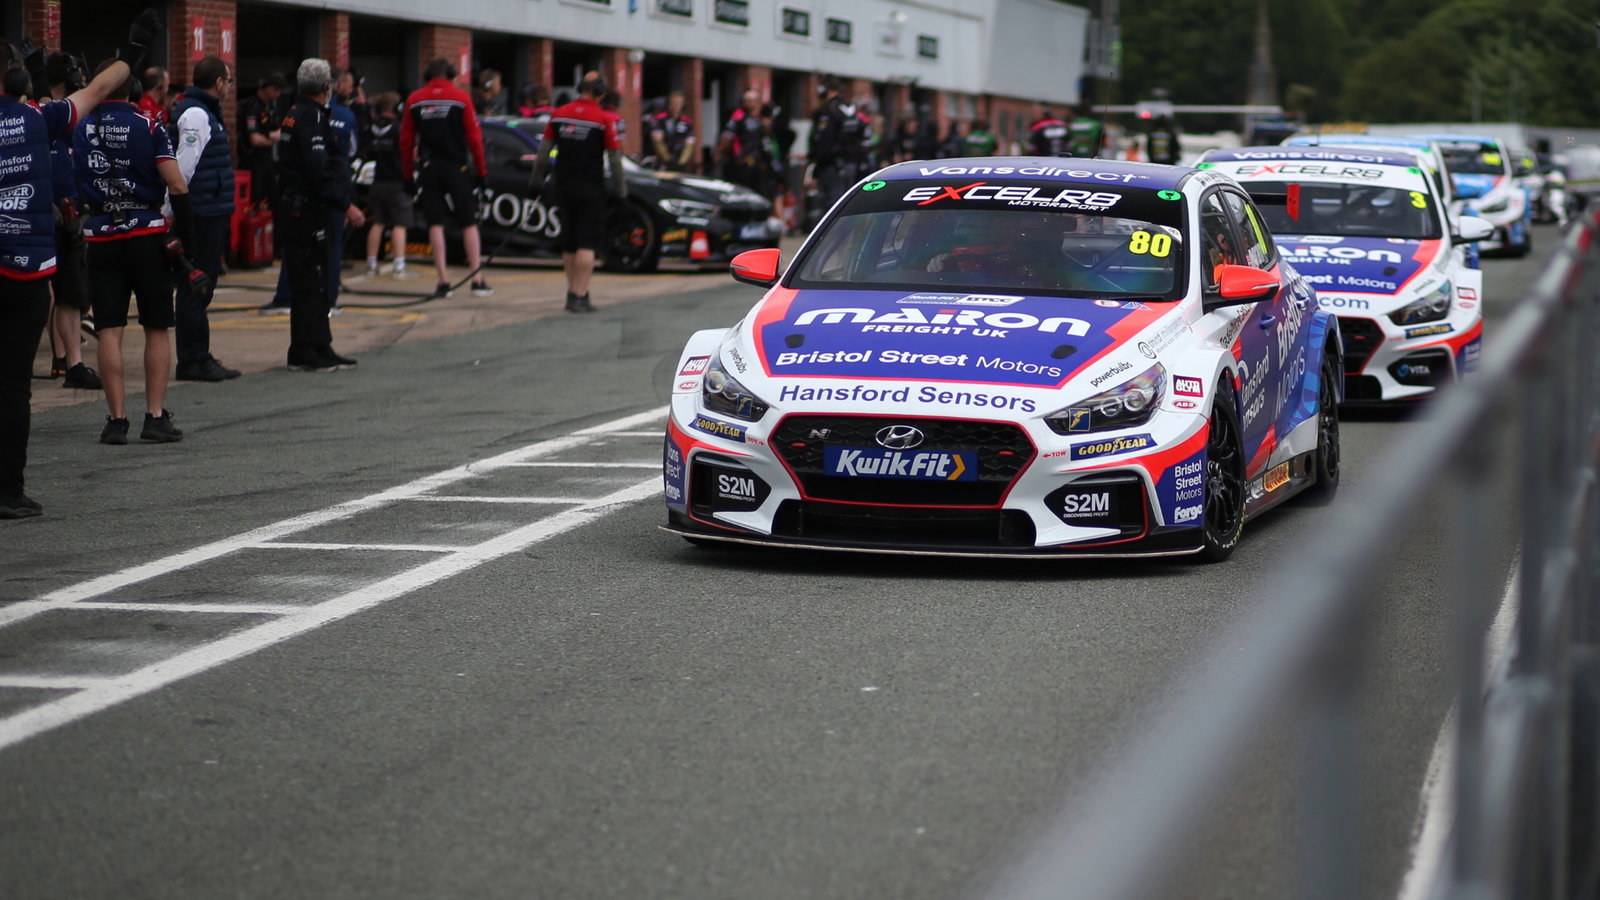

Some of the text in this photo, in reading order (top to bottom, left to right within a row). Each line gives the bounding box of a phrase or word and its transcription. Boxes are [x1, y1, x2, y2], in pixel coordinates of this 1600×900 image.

[194, 27, 203, 51] 11
[0, 116, 25, 127] ristol
[105, 126, 130, 134] Bristol
[105, 133, 128, 141] Street
[1236, 163, 1384, 179] EXCELR8
[0, 187, 29, 198] APER
[902, 181, 1122, 207] EXCELR8
[1409, 191, 1427, 209] 3
[1007, 200, 1110, 212] MOTORSPORT
[1129, 230, 1172, 258] 80
[1326, 257, 1352, 265] UK
[1338, 275, 1397, 290] Motors
[861, 324, 1010, 338] FREIGHT UK
[775, 350, 1062, 378] Bristol Street Motors
[1409, 365, 1430, 375] VITA
[1090, 360, 1134, 388] powerbulbs
[778, 384, 1036, 414] Hansford Sensors
[696, 417, 741, 438] GOODYEAR
[1052, 450, 1067, 458] TOW
[1078, 436, 1148, 456] GOODYEAR
[1174, 459, 1202, 478] Bristol
[718, 474, 755, 497] S2M
[1175, 475, 1202, 491] Street
[1063, 492, 1109, 513] S2M
[1175, 488, 1202, 503] Motors
[1174, 503, 1203, 521] Forge
